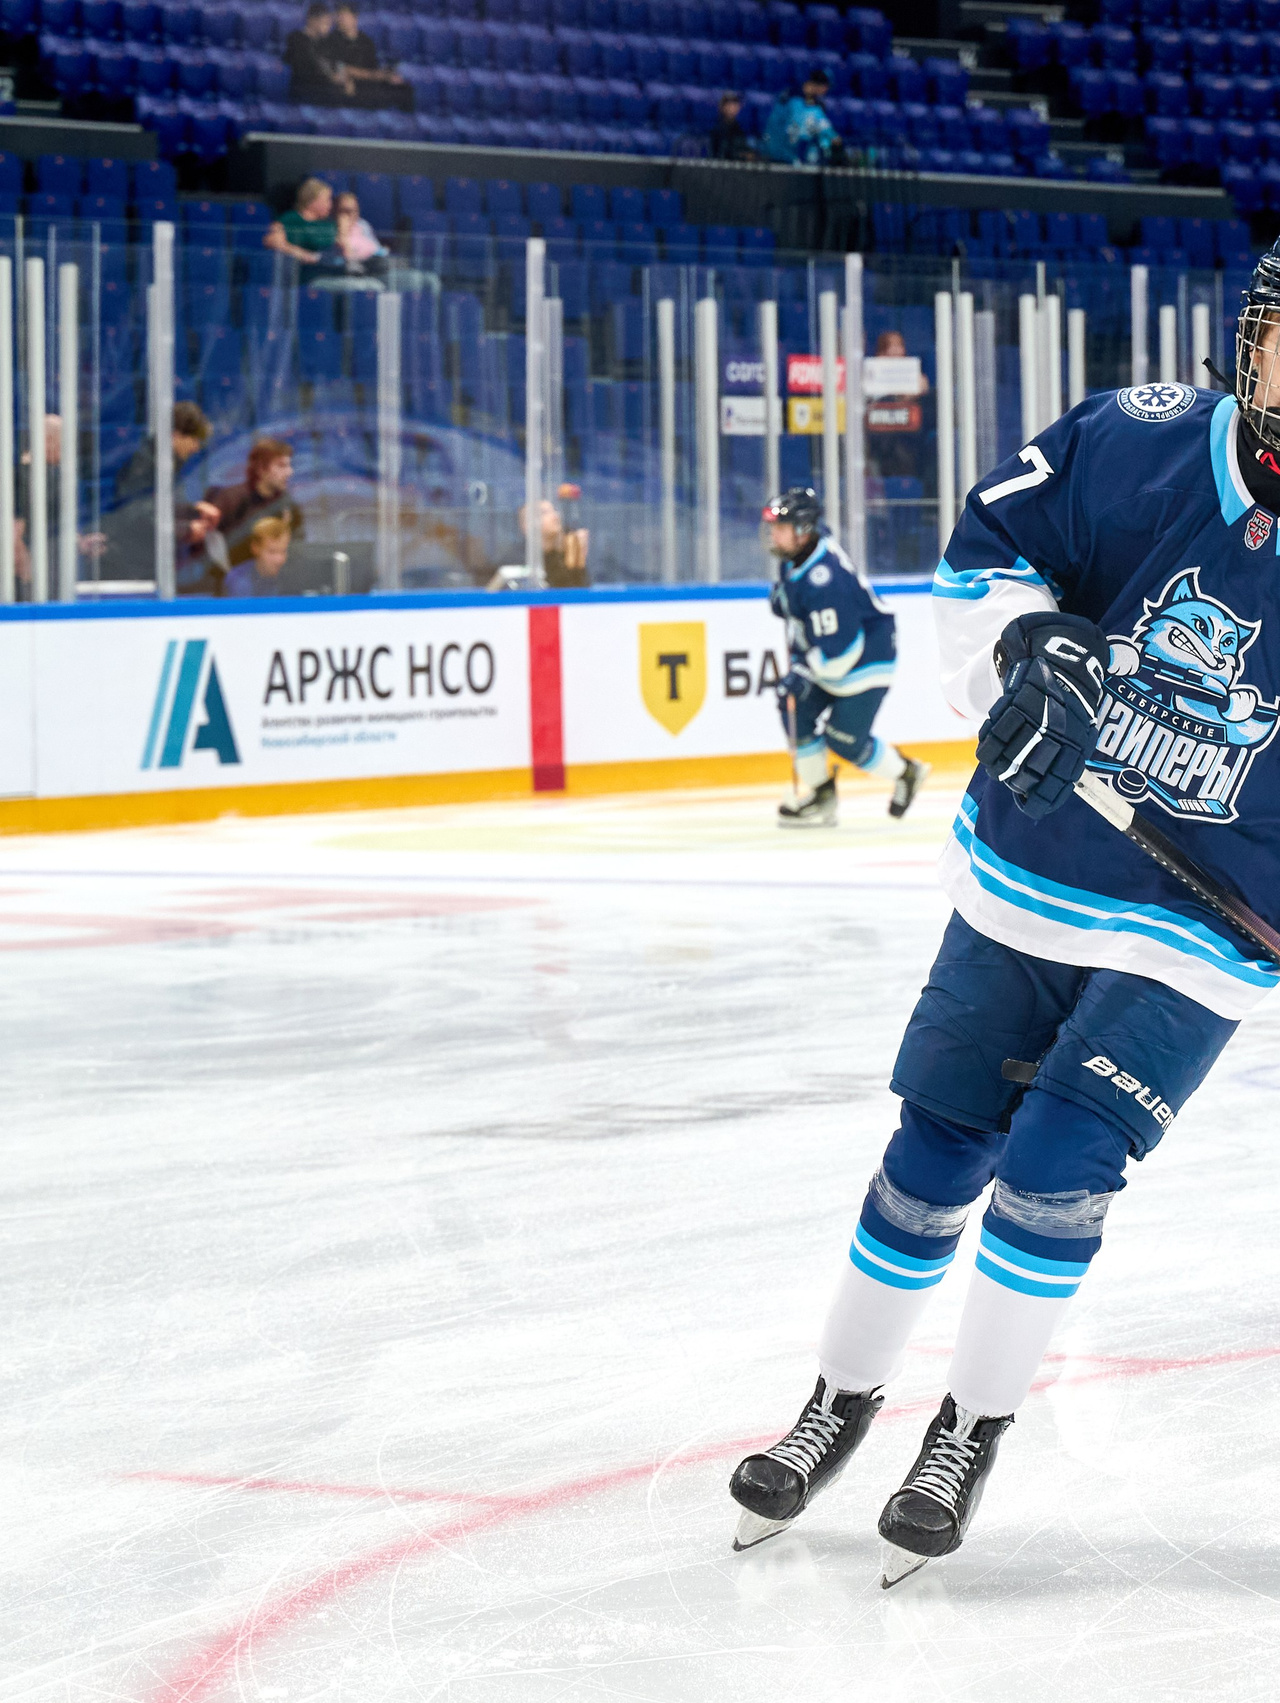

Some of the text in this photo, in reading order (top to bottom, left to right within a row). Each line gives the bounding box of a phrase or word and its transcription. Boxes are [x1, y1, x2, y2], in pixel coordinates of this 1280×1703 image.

[809, 607, 839, 637] 19
[263, 641, 497, 706] АРЖС НСО
[1116, 684, 1215, 738] СИБИРСКИЕ
